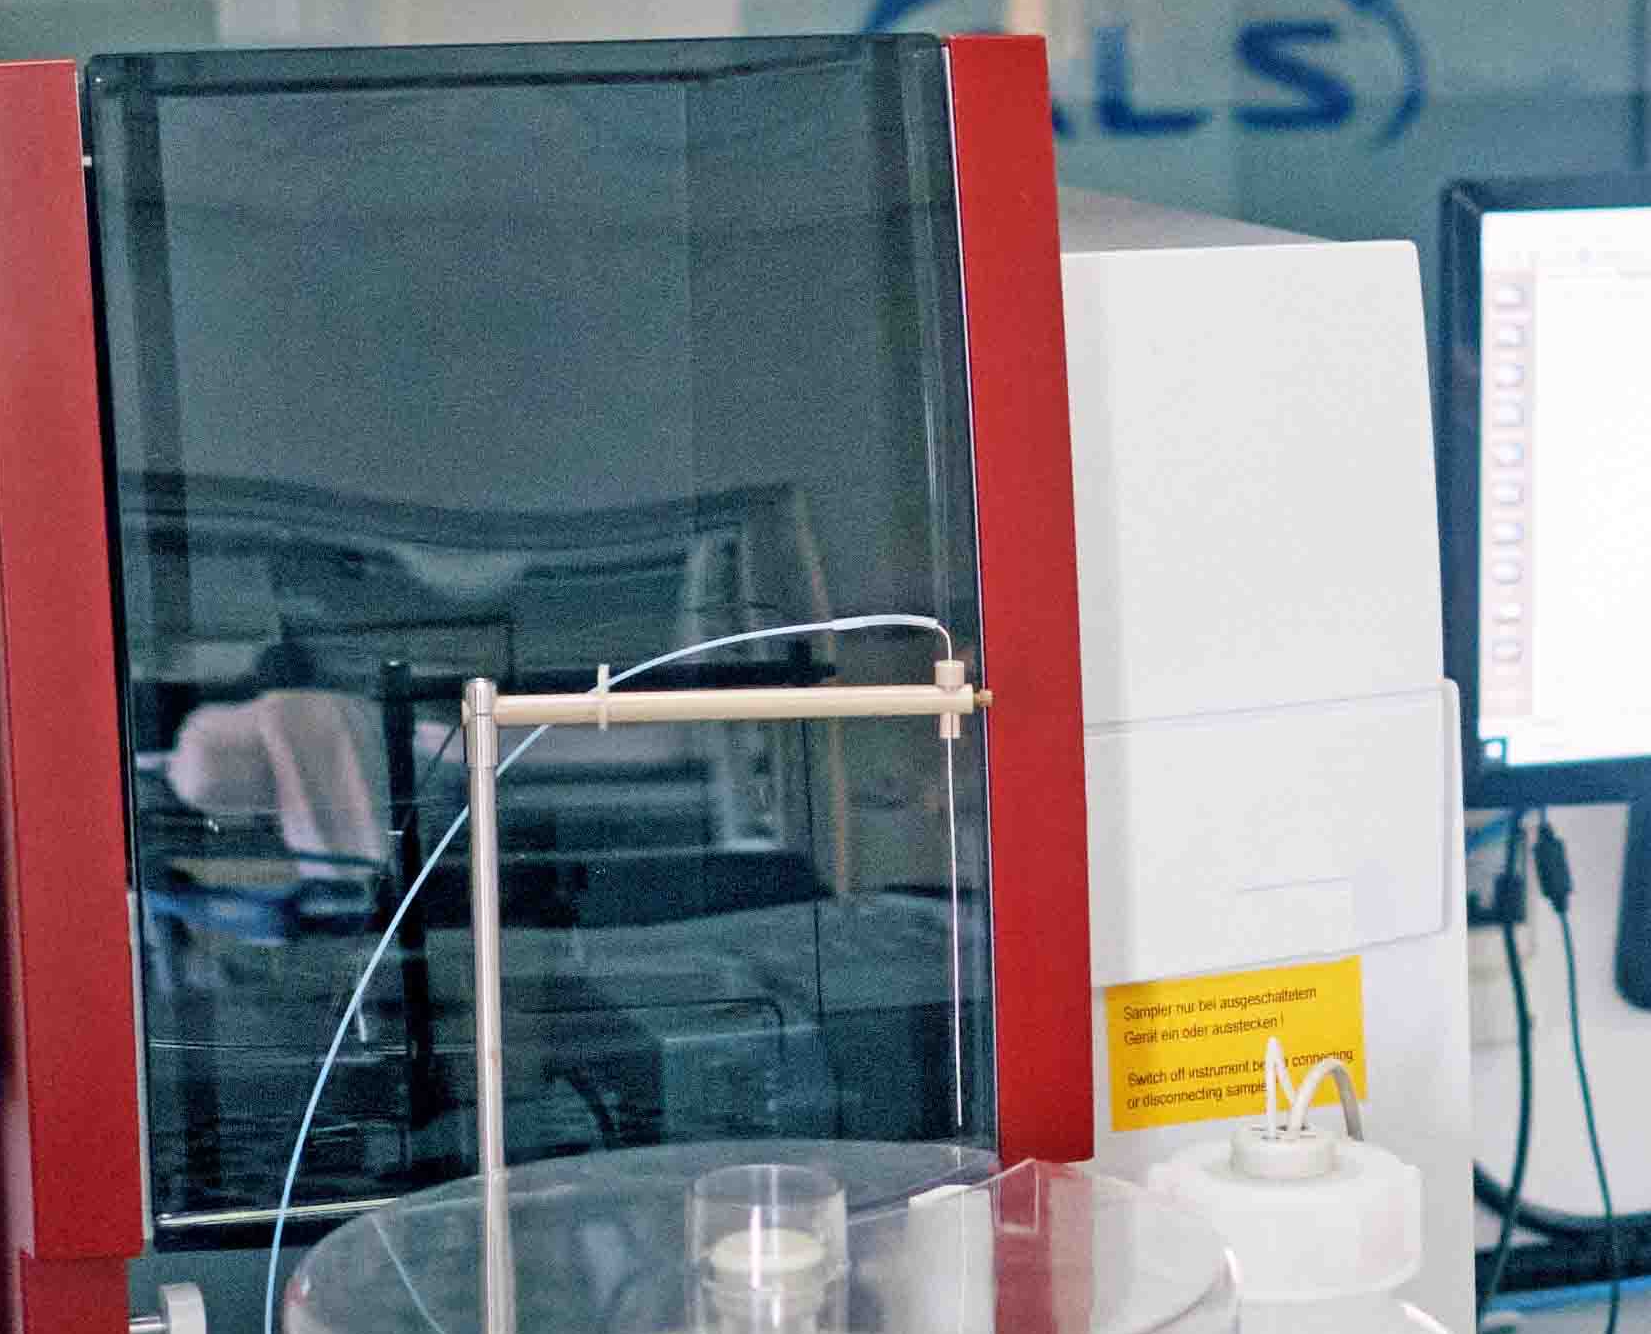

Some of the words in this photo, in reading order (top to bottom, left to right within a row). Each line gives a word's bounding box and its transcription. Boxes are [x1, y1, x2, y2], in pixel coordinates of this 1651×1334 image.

[1052, 22, 1356, 137] LS
[1124, 1001, 1172, 1022] Sampler
[1176, 1001, 1195, 1014] nur
[1198, 997, 1217, 1012] bei
[1161, 1026, 1180, 1042] ein
[1182, 1021, 1208, 1040] oder
[1212, 1016, 1278, 1036] ausstecken
[1128, 1068, 1167, 1087] Switch
[1171, 1067, 1186, 1083] off
[1189, 1060, 1249, 1079] instrument
[1126, 1097, 1139, 1109] or
[1142, 1085, 1223, 1108] disconnecting
[1226, 1078, 1268, 1098] sample
